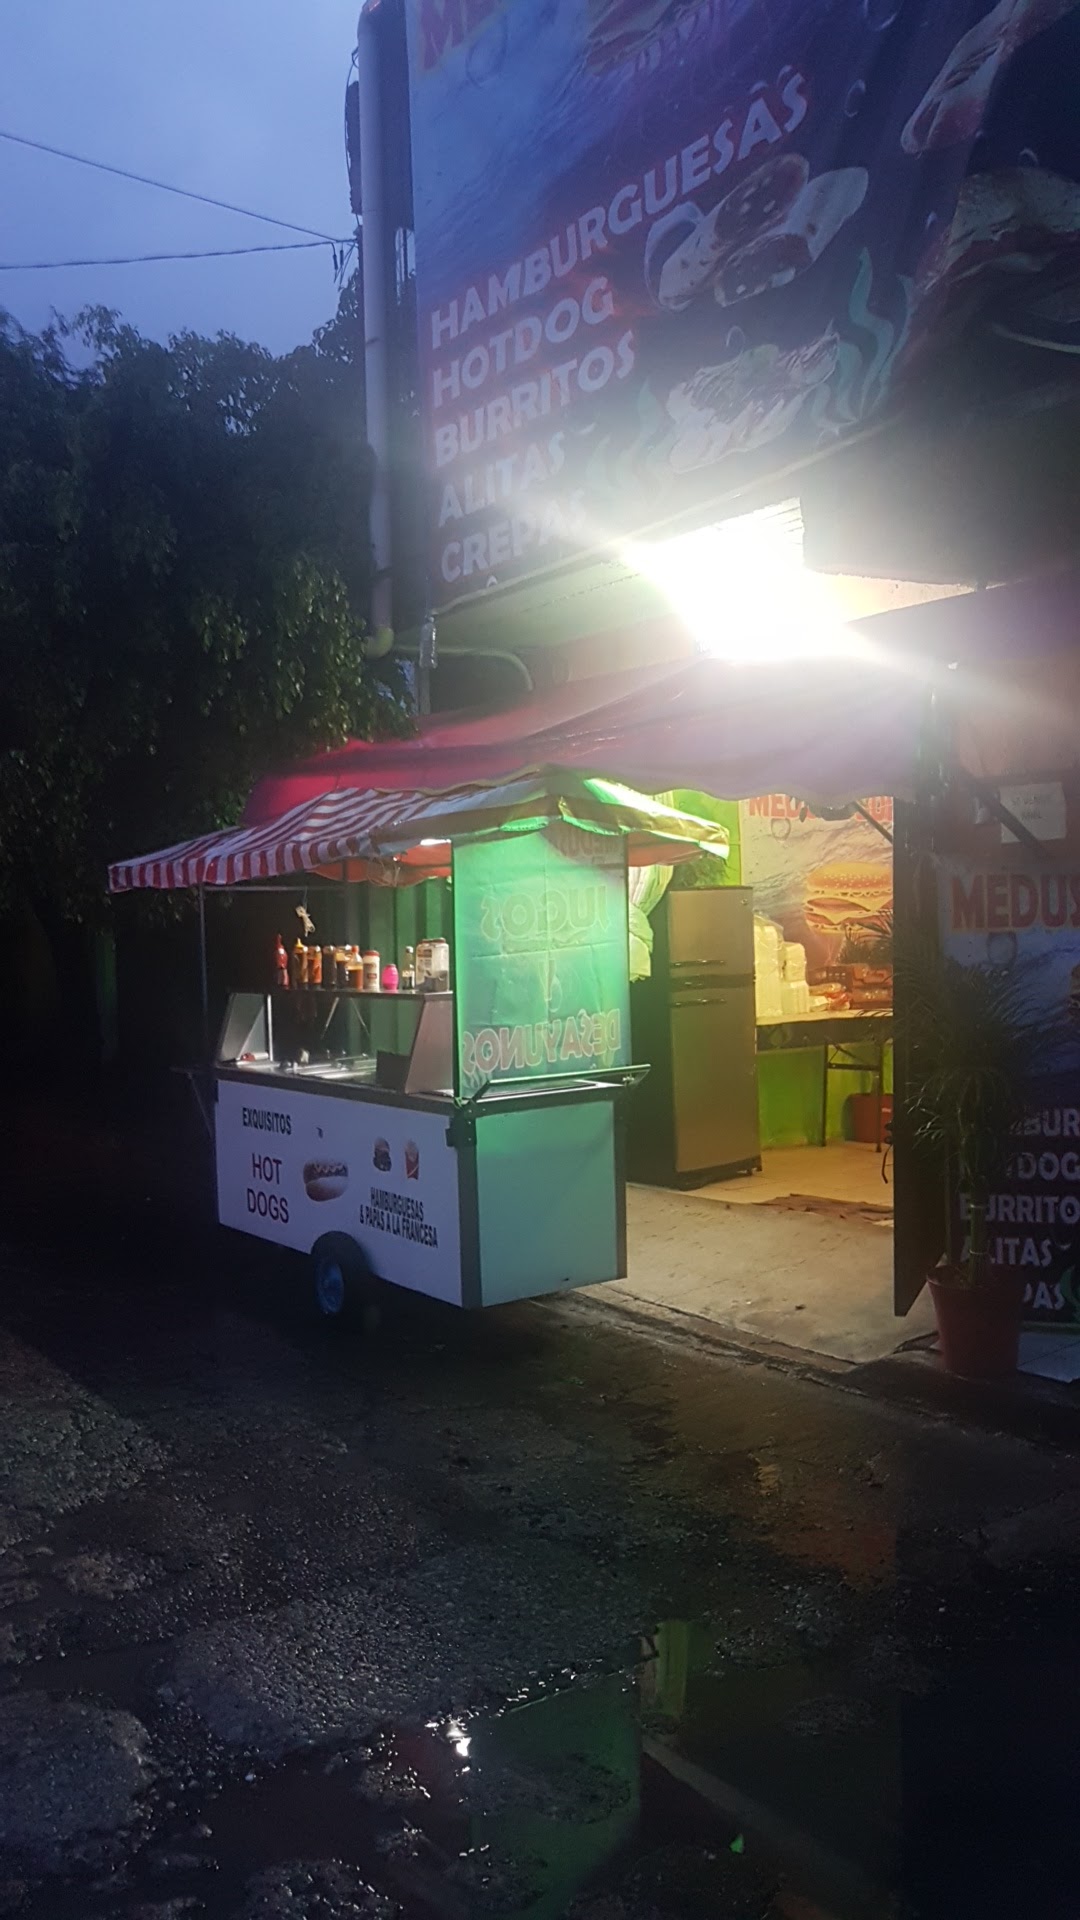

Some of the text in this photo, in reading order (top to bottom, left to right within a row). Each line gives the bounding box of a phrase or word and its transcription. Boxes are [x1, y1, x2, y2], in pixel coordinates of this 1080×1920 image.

[431, 73, 808, 350] HAMBURGUESAS
[433, 276, 613, 409] HOTDOG
[434, 330, 634, 467] BURRITOS
[438, 431, 565, 528] ALITAS
[441, 489, 587, 583] CREPAS
[242, 1107, 292, 1136] EXQUISITOS
[252, 1152, 283, 1185] HOT
[246, 1187, 290, 1224] DOGS
[365, 1205, 384, 1231] PAPAS
[402, 1216, 438, 1248] FRANCESA
[370, 1186, 424, 1223] HAMBURGUESAS
